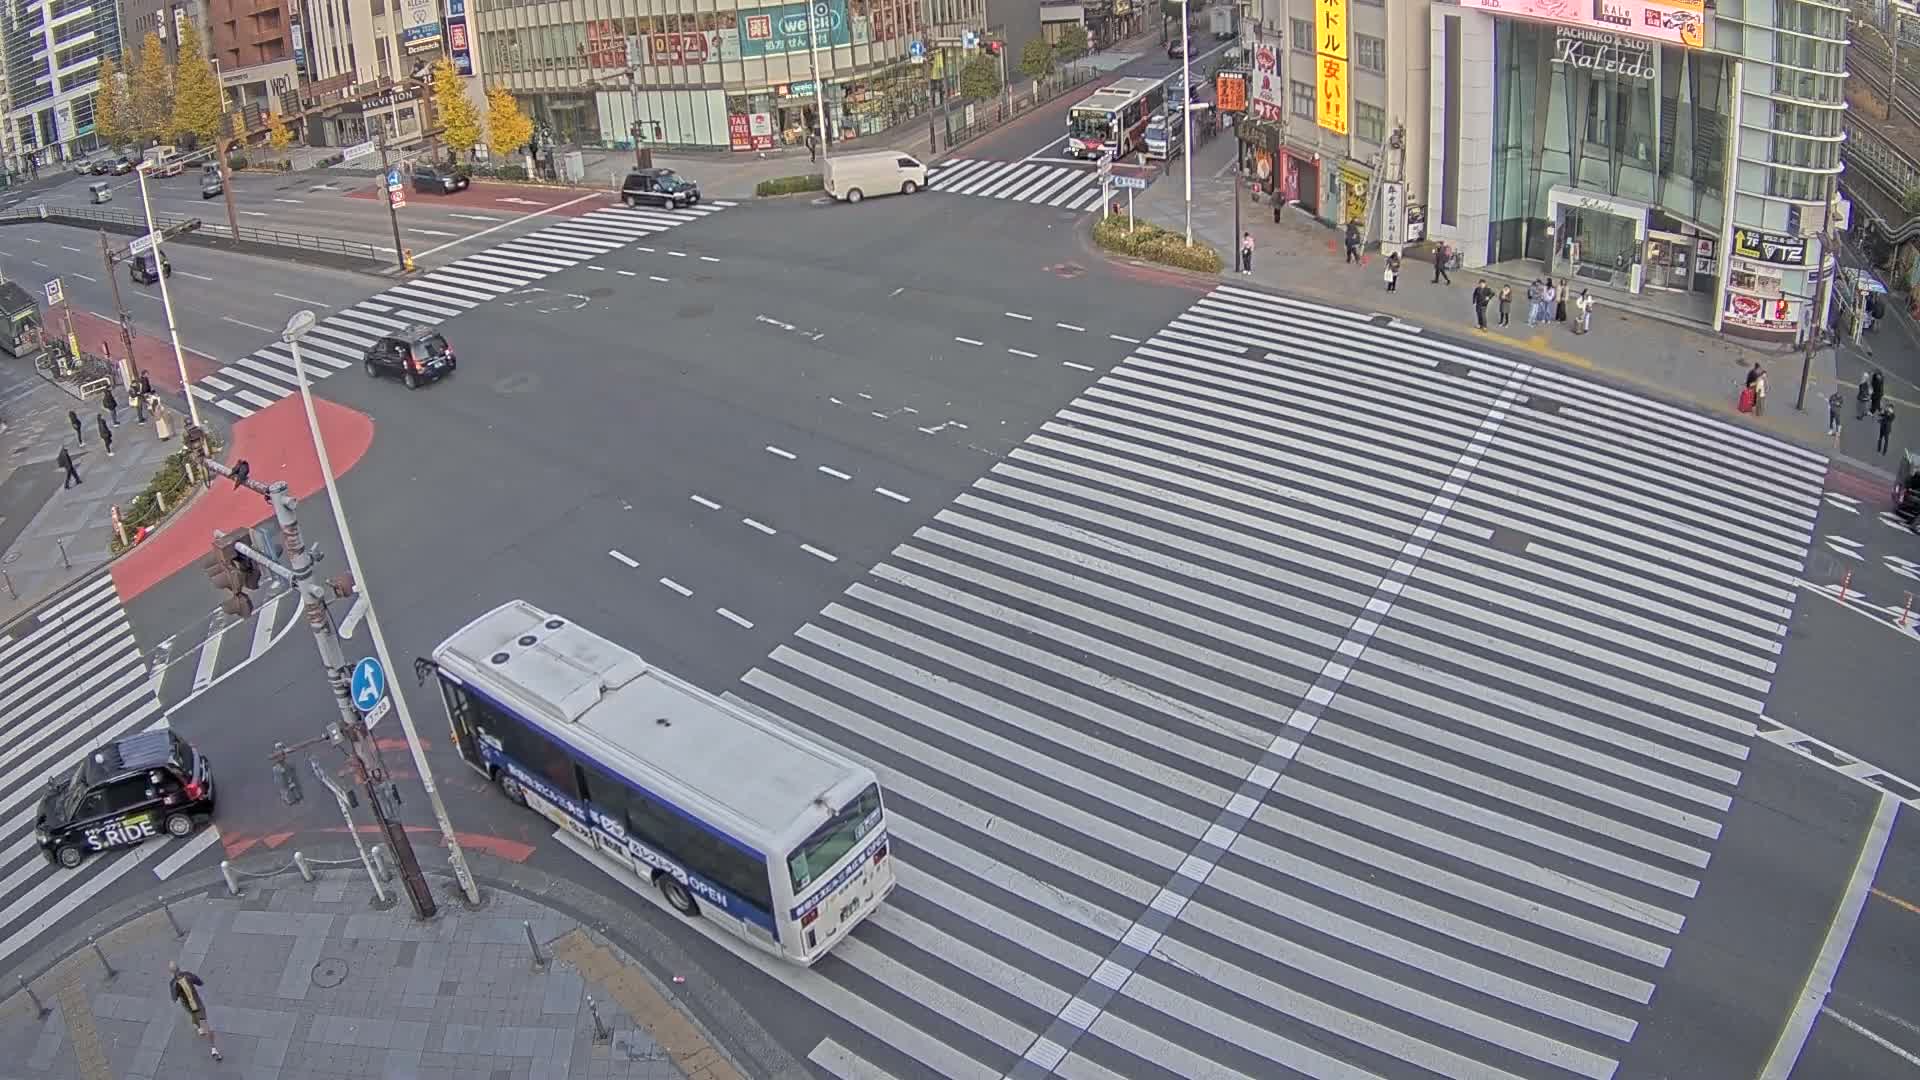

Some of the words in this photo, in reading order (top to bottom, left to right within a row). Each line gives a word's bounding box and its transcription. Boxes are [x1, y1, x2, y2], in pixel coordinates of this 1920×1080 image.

[765, 33, 828, 51] 処方せん付
[1555, 26, 1613, 44] PACHINKO
[1550, 38, 1656, 80] Kaleido
[730, 116, 747, 125] TAX
[87, 820, 157, 851] S.RIDE
[688, 876, 728, 908] OPEN
